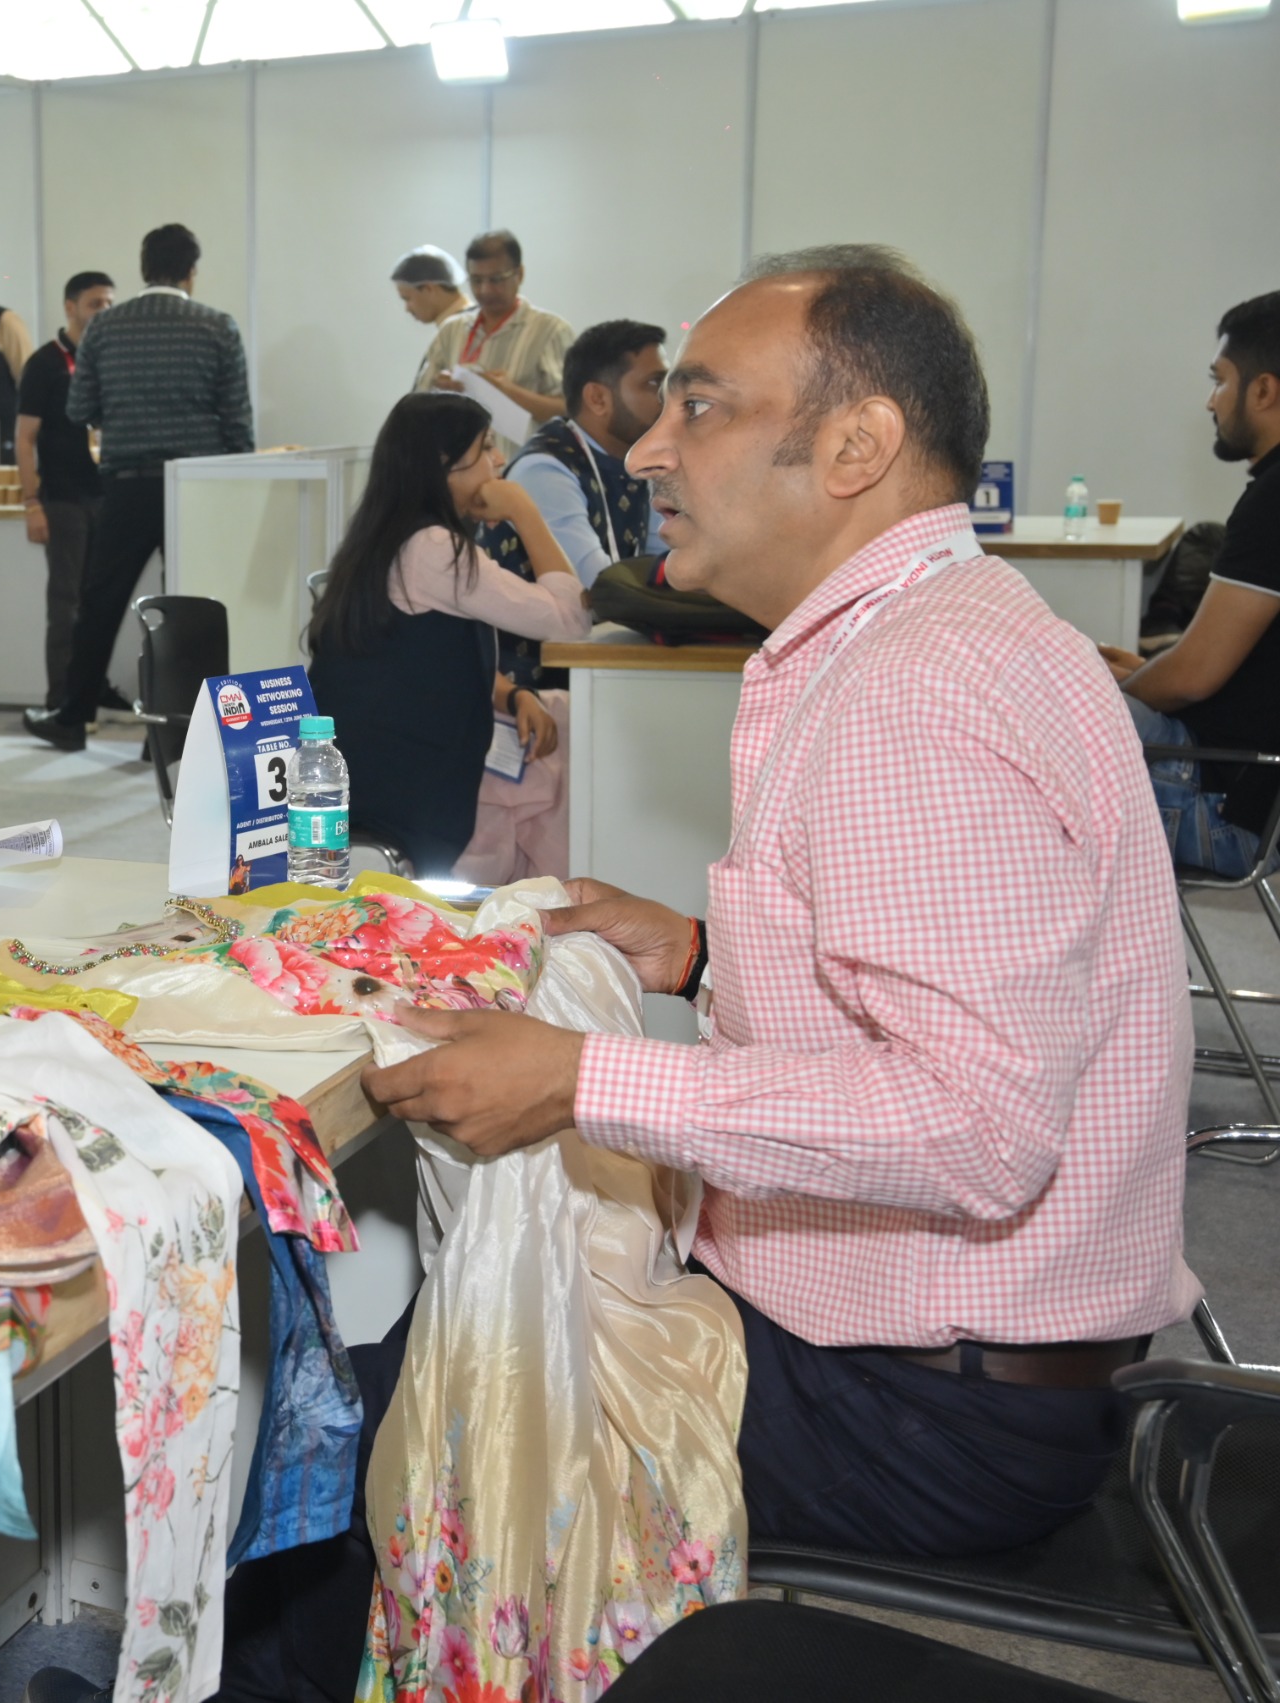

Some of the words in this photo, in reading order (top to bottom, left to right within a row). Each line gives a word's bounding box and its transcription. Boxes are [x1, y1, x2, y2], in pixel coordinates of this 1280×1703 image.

[984, 490, 991, 505] 1
[900, 561, 929, 588] INDIA
[849, 588, 899, 628] GARMENT
[259, 676, 293, 690] BUSINESS
[256, 688, 303, 704] NETWORKING
[269, 702, 299, 715] SESSION
[257, 742, 278, 753] TABLE
[278, 740, 292, 750] NO.
[267, 756, 288, 802] 3
[236, 820, 252, 829] AGENT
[255, 813, 283, 825] DISTRIBUTOR
[248, 836, 274, 850] AMBALA
